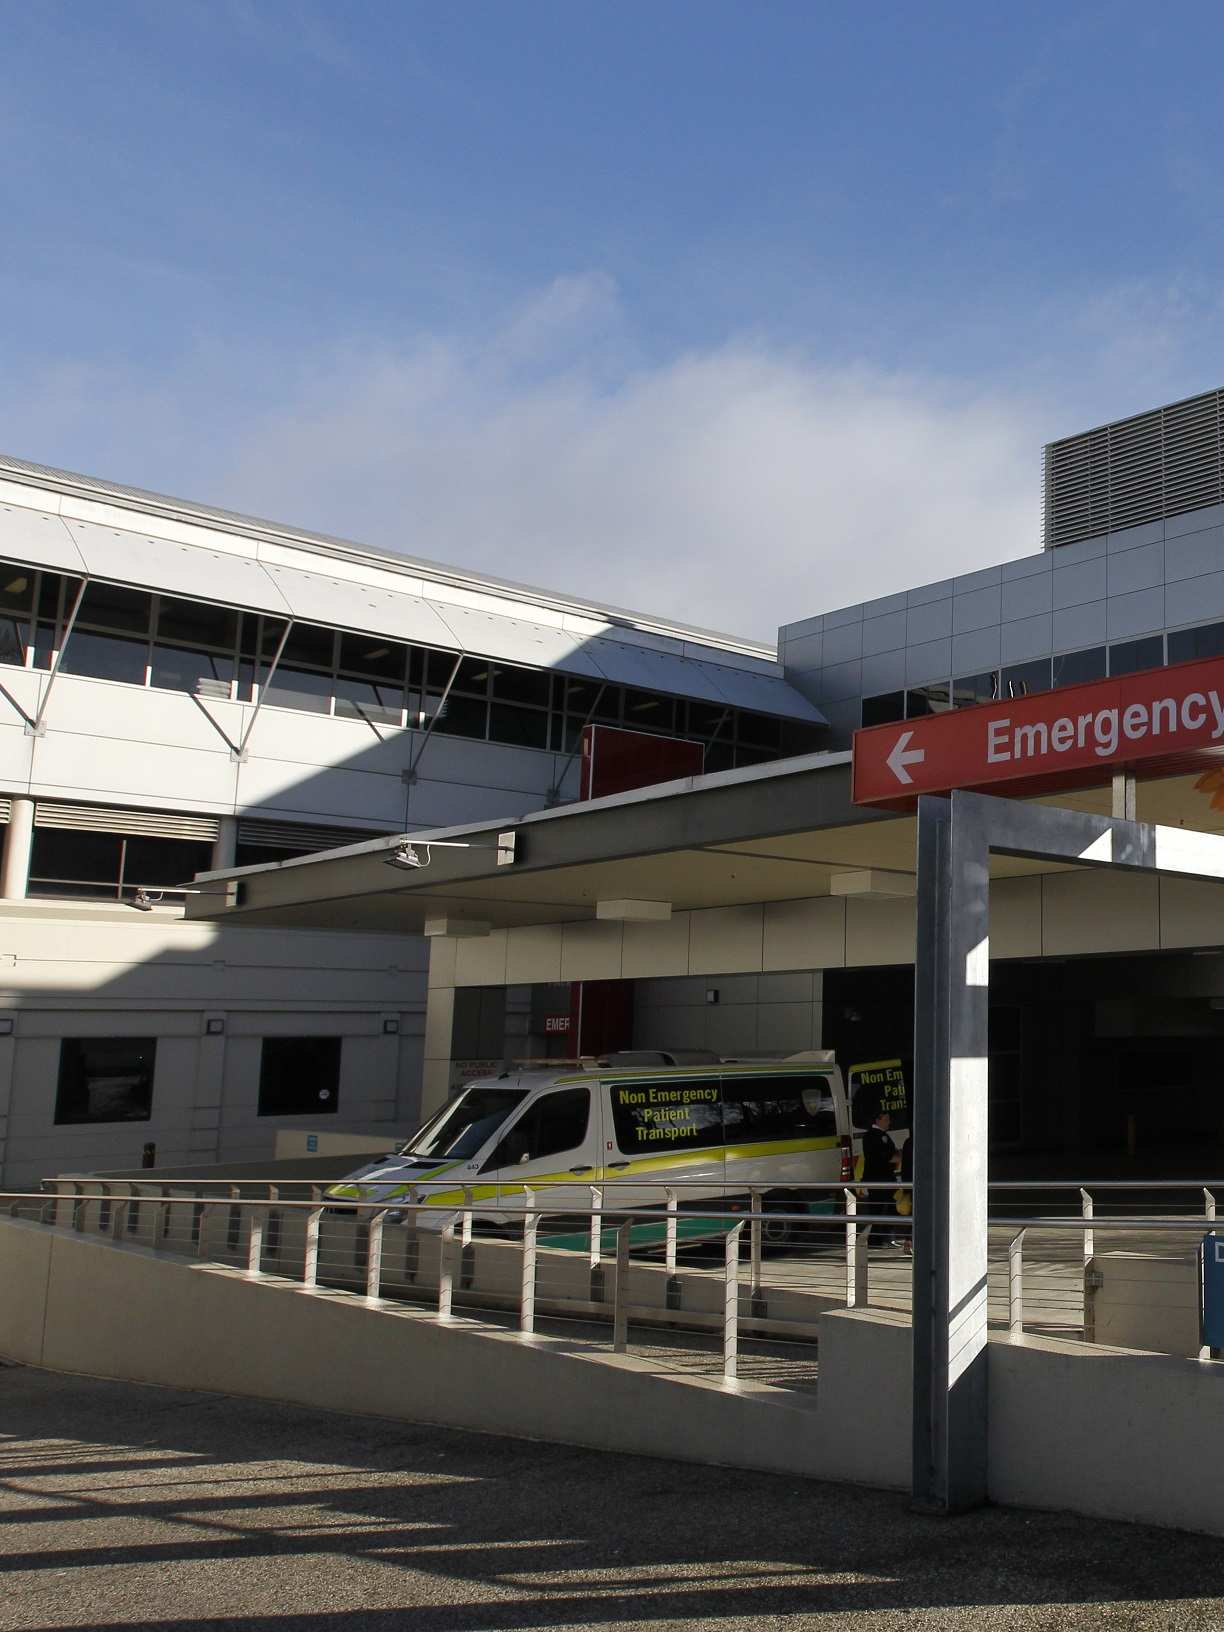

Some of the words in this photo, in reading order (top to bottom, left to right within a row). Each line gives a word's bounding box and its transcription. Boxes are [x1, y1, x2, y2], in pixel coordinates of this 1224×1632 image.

[861, 1071, 884, 1085] Non
[619, 1090, 646, 1104] Non
[649, 1087, 719, 1103] Emergency
[643, 1107, 690, 1123] Patient
[635, 1123, 698, 1141] Transport
